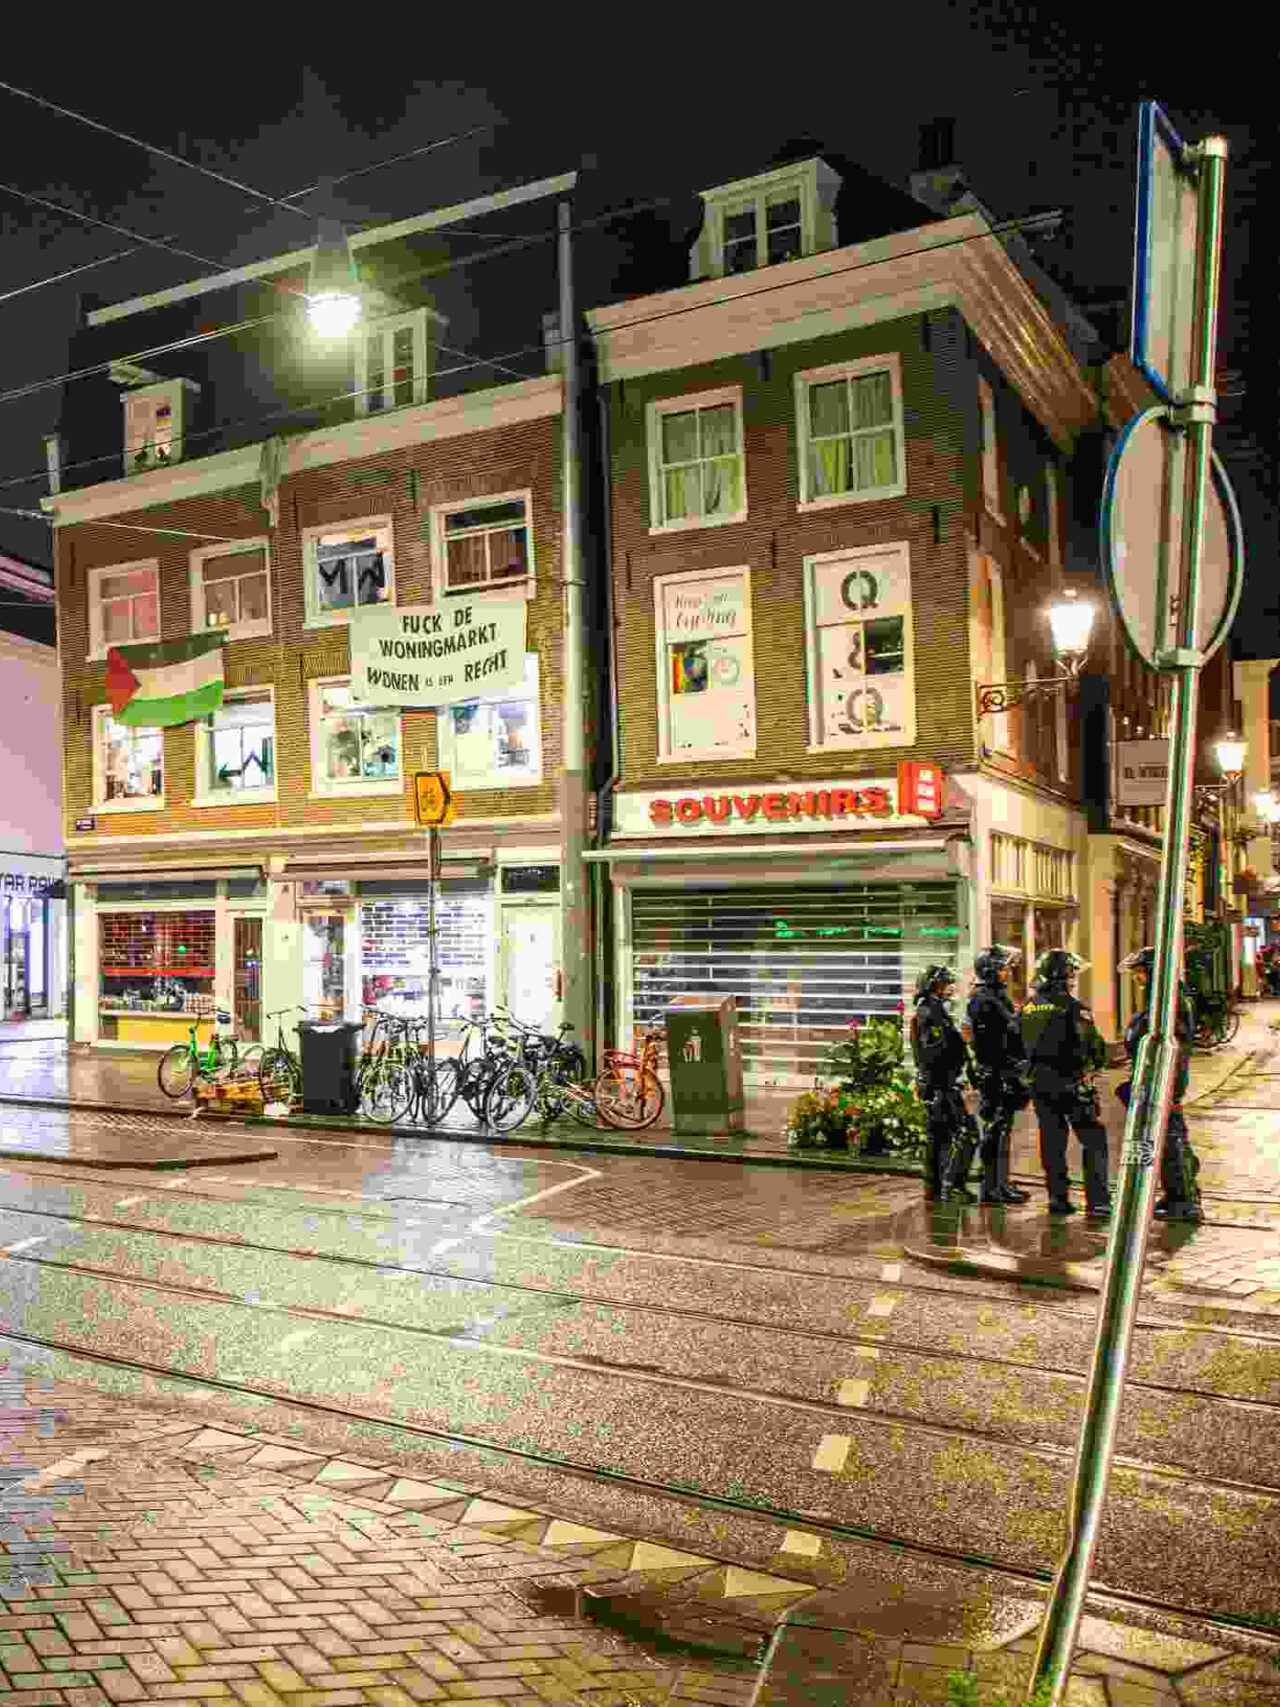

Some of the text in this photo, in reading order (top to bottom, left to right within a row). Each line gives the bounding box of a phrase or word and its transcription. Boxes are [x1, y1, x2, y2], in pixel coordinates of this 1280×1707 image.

[402, 606, 472, 634] FUCK DE
[379, 623, 496, 659] WONINGMARKT
[367, 667, 419, 691] WONEN
[464, 649, 507, 682] RECHT
[649, 787, 892, 823] SOUVENIRS
